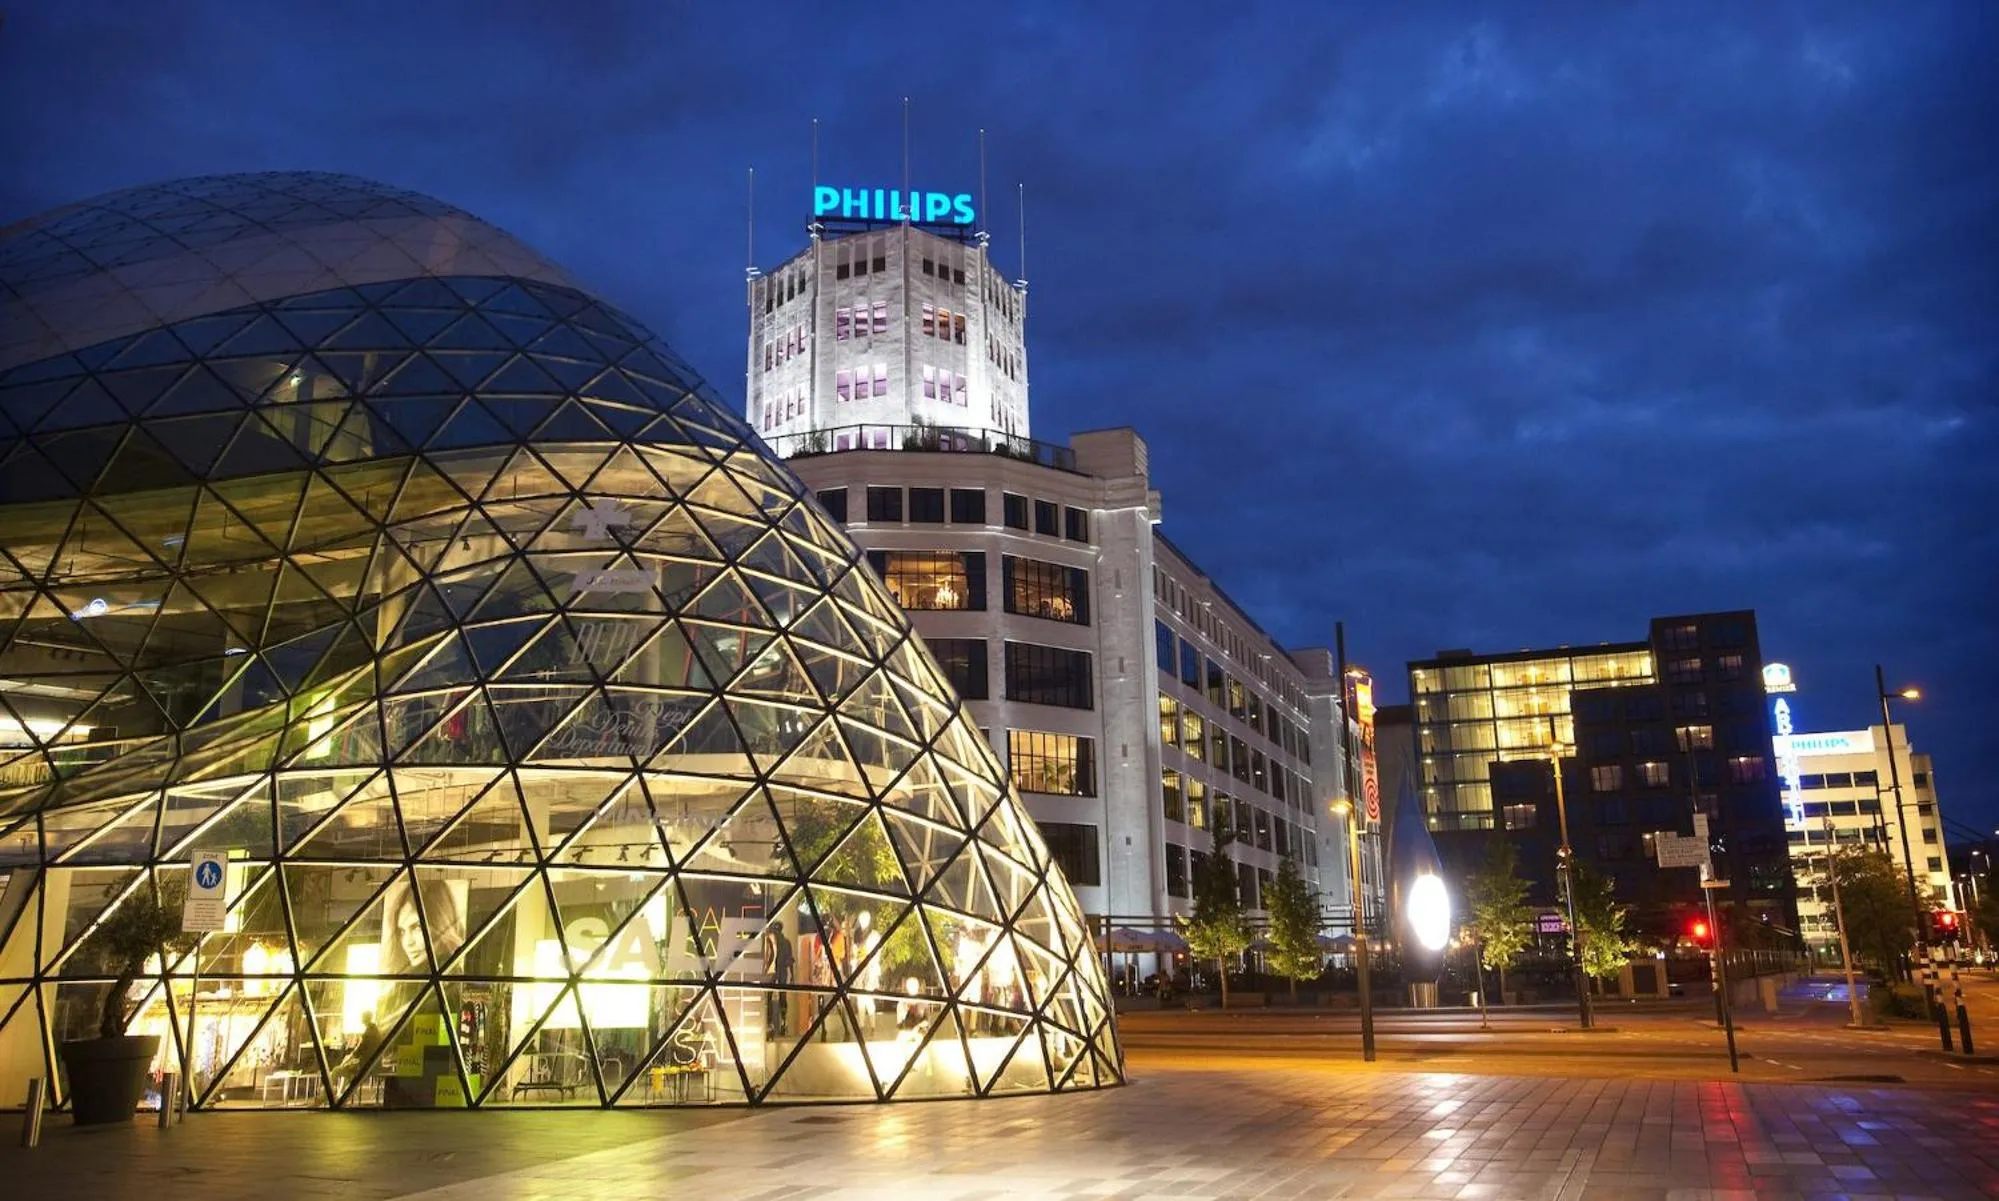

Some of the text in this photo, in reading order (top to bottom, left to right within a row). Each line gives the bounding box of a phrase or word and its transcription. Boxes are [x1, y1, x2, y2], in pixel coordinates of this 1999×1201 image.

[814, 186, 976, 225] PHILIPS
[563, 916, 766, 974] SALE
[674, 1031, 762, 1065] SALE
